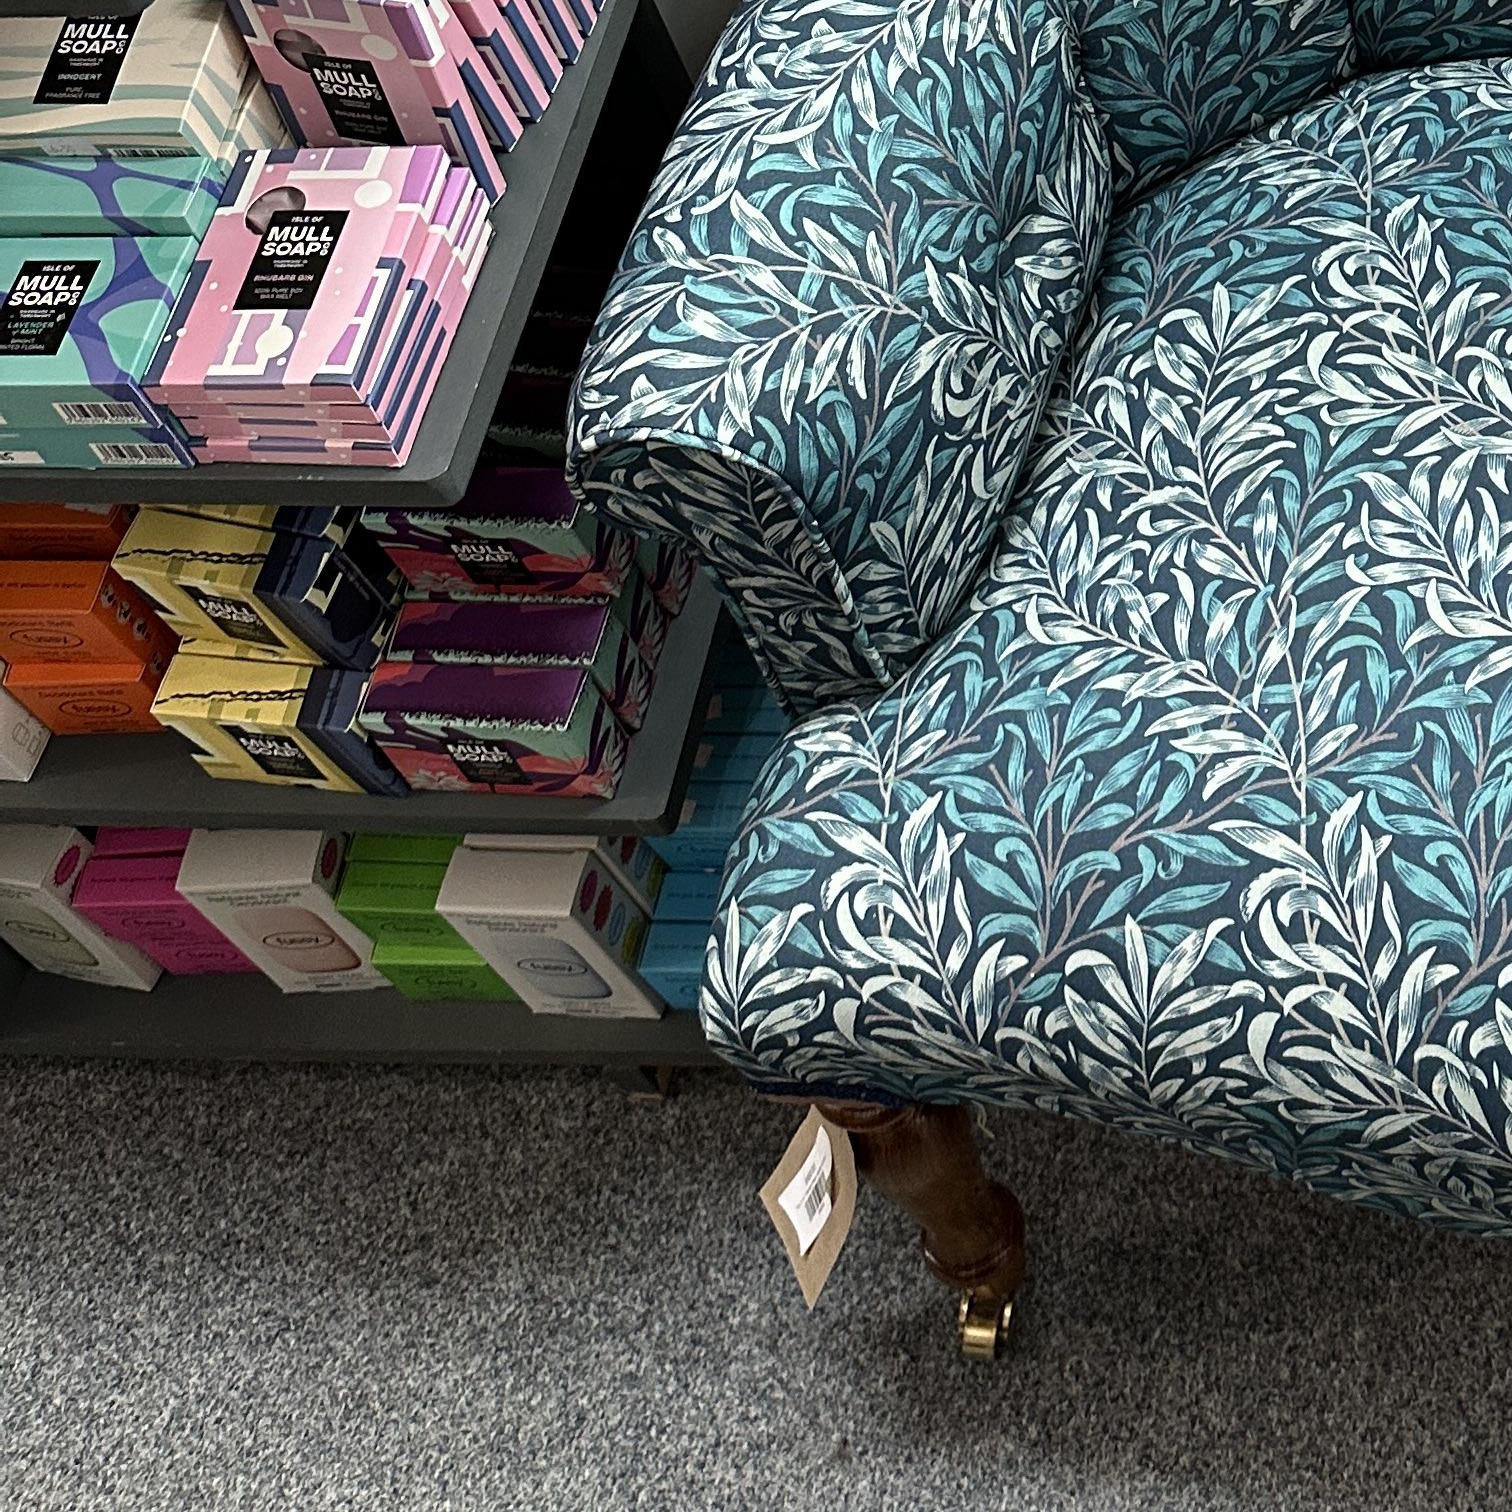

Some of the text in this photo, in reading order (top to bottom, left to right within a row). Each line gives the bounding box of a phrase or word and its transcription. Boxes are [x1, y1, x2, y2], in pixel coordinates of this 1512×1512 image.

[63, 23, 129, 39] MULL
[57, 40, 117, 54] SOAP
[313, 68, 377, 88] MULL
[320, 82, 373, 99] SOAP
[267, 226, 334, 242] MULL
[261, 242, 321, 256] SOAP
[42, 264, 62, 272] ISLE
[16, 275, 84, 291] MULL
[8, 291, 71, 306] SOAP
[451, 544, 513, 555] MULL
[458, 553, 510, 562] SOAP
[199, 599, 250, 616] MULL
[240, 737, 293, 750] MULL
[447, 744, 508, 755] MULL
[453, 753, 504, 762] SOAP
